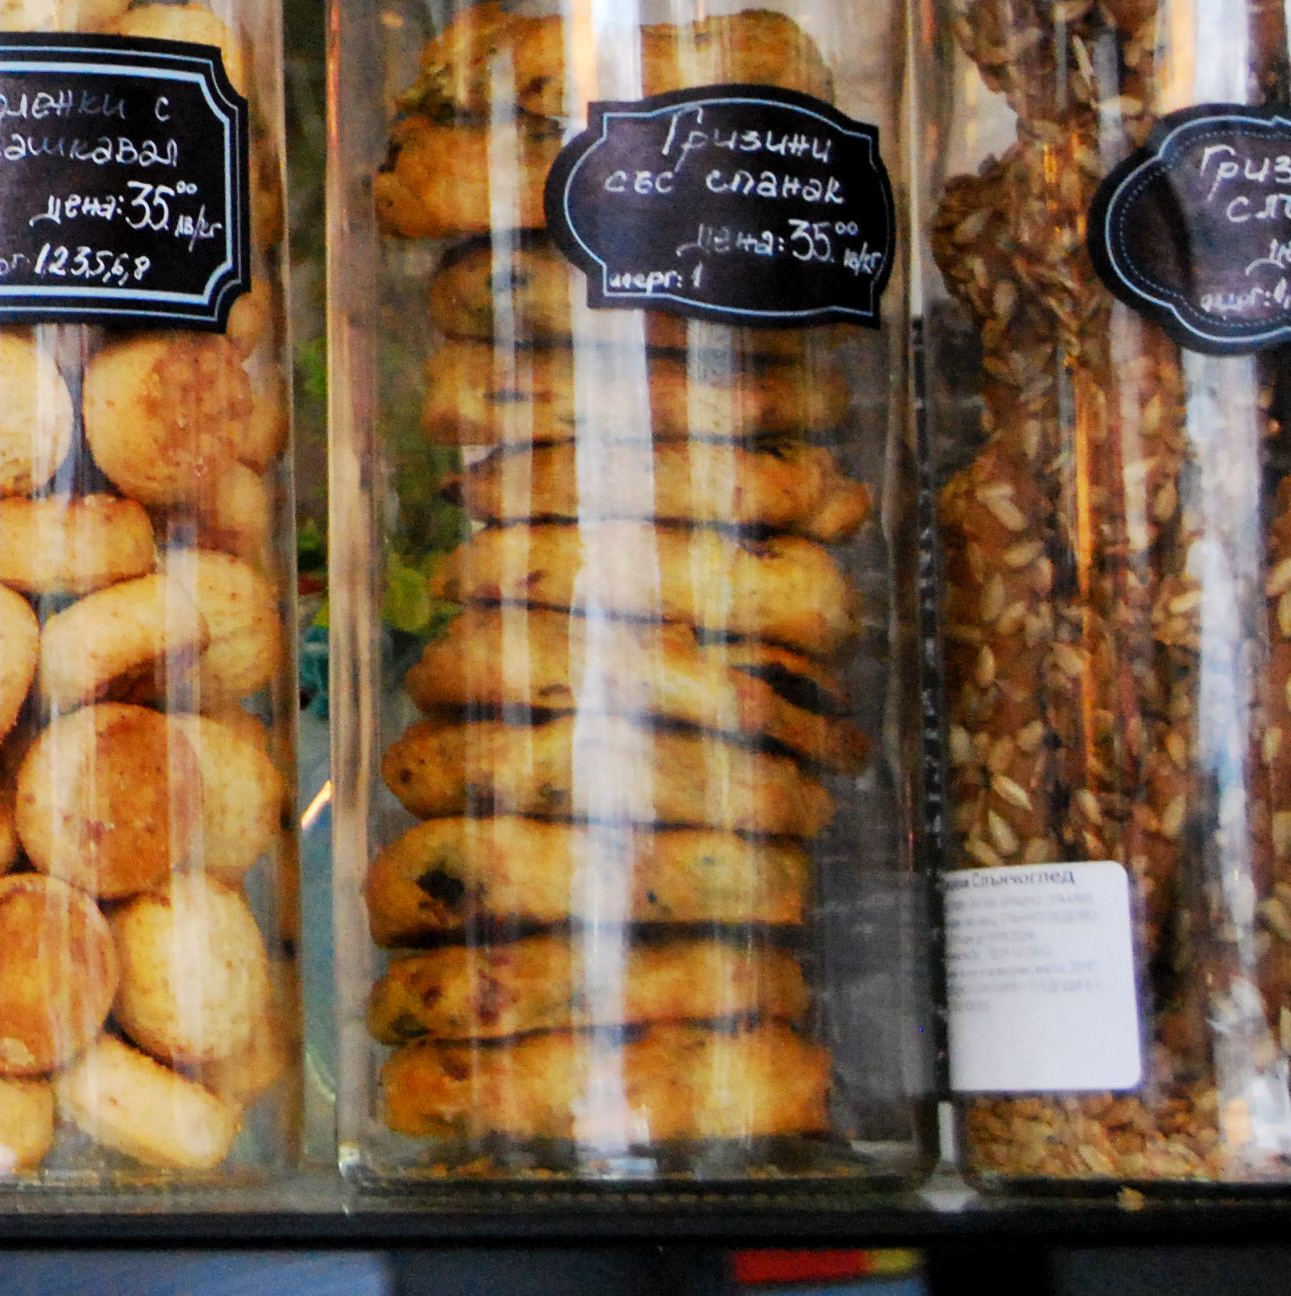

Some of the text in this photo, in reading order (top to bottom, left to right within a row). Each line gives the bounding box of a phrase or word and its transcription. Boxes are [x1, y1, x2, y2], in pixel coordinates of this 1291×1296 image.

[154, 96, 171, 123] с
[662, 105, 832, 171] Гризини
[706, 168, 846, 205] спанак
